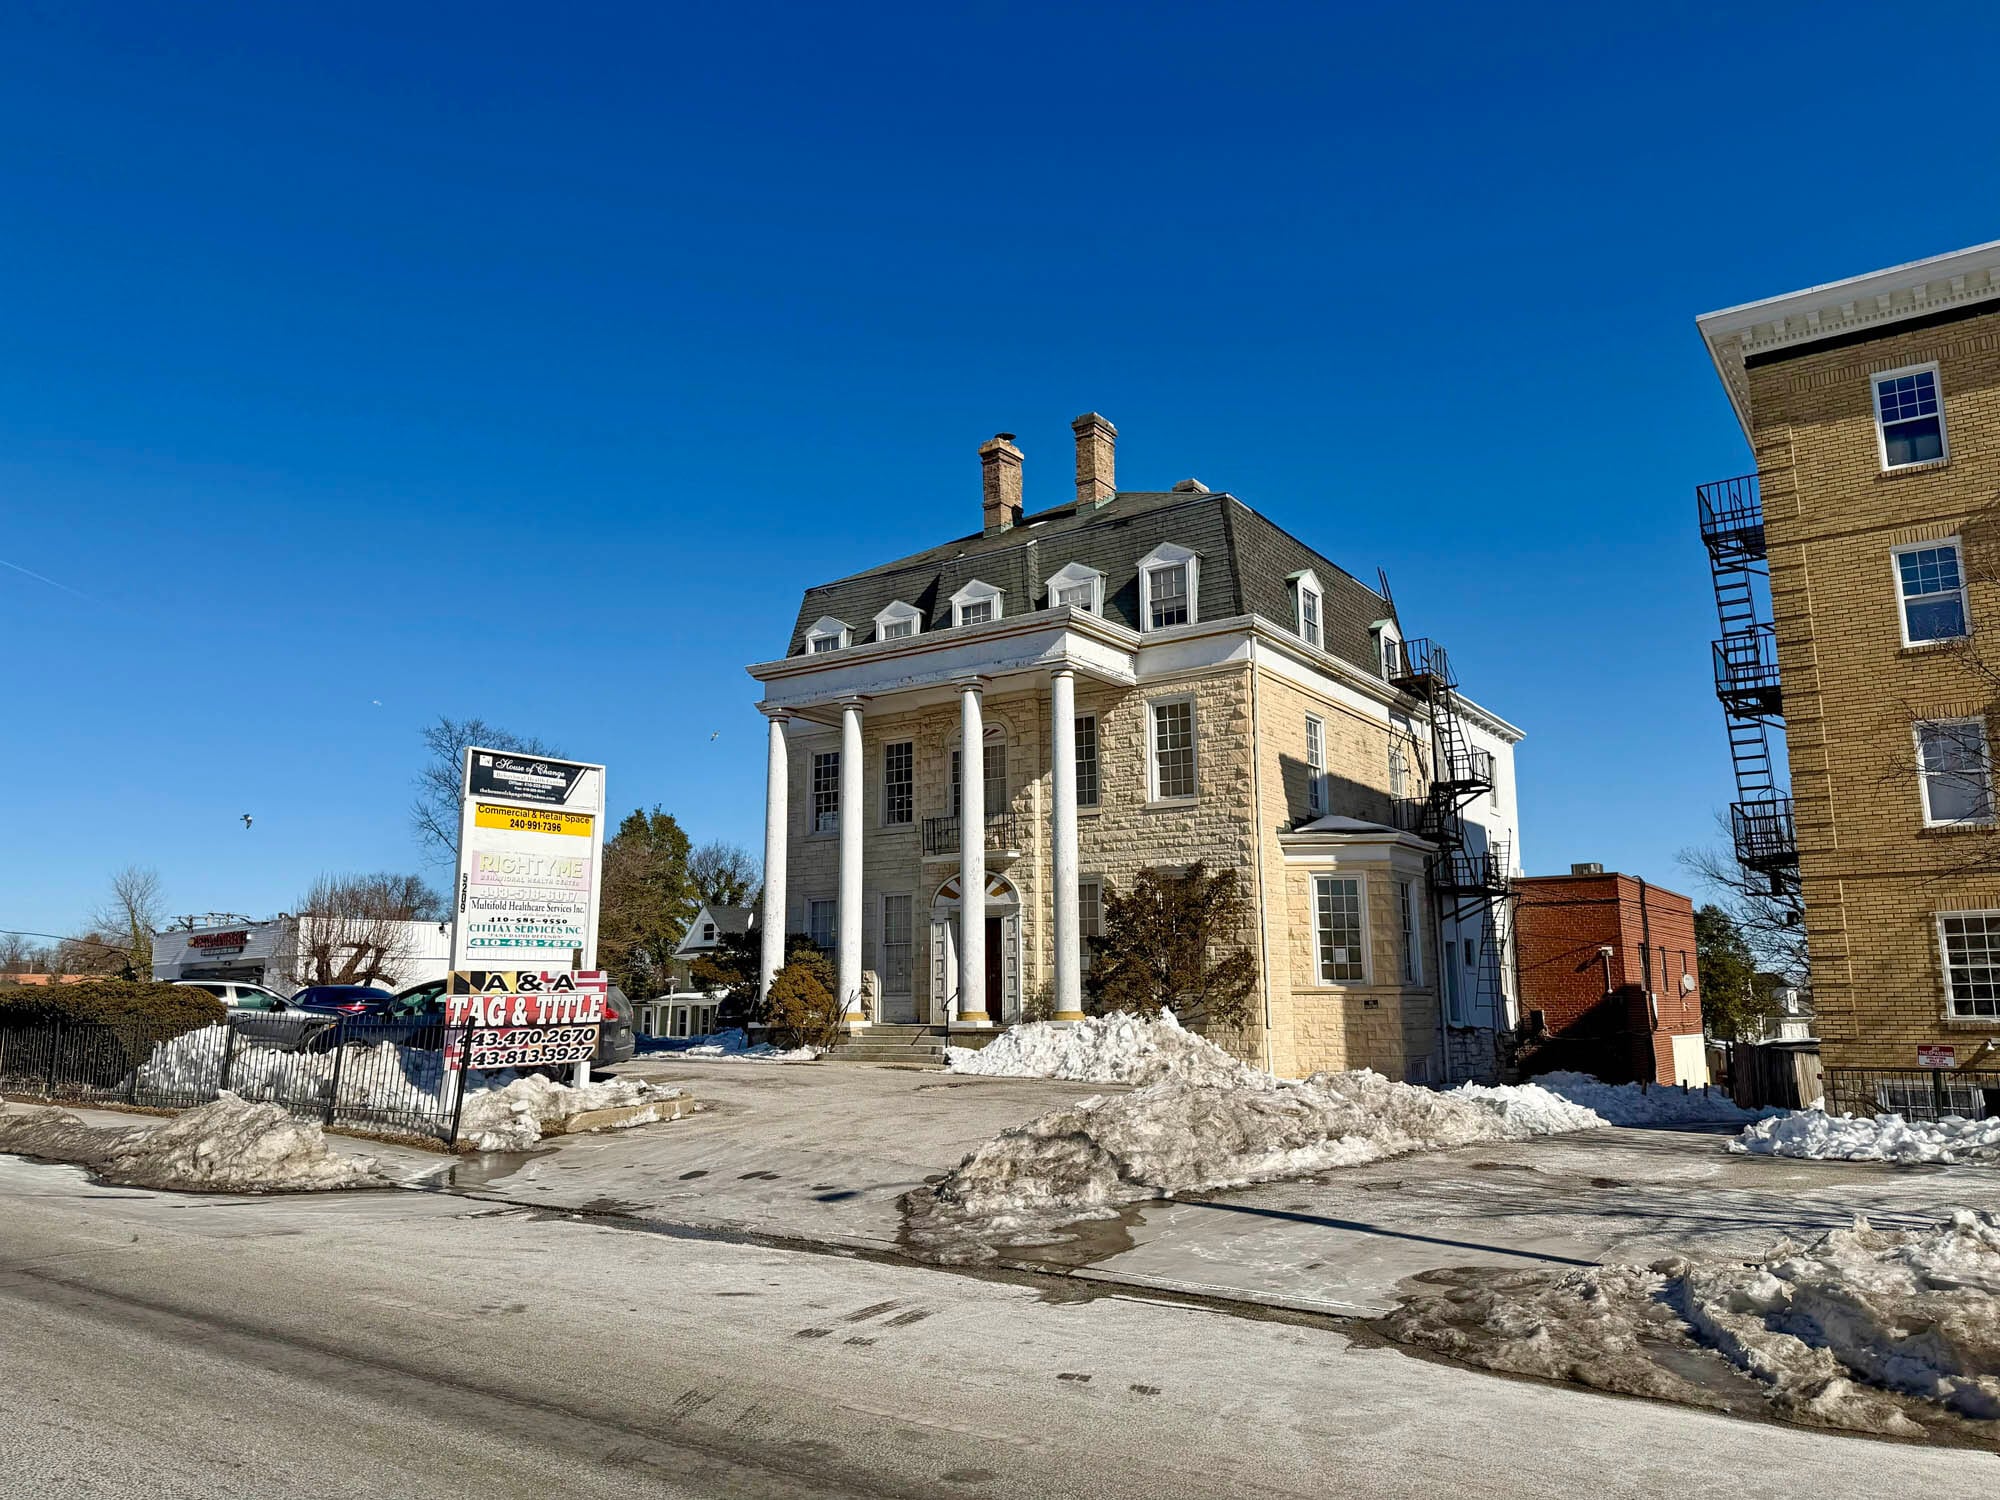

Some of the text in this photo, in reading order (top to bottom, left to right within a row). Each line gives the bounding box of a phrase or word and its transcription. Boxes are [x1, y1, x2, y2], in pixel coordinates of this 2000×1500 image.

[496, 758, 566, 778] House of Change
[478, 805, 590, 824] Commercial & Retail Space
[510, 819, 562, 832] 240-991-7396
[472, 899, 585, 914] Multifold Healthcare Services Inc.
[514, 926, 562, 934] SERVICES
[565, 926, 583, 935] INC.
[484, 974, 576, 992] A & A
[450, 995, 604, 1027] TAG & TITLE
